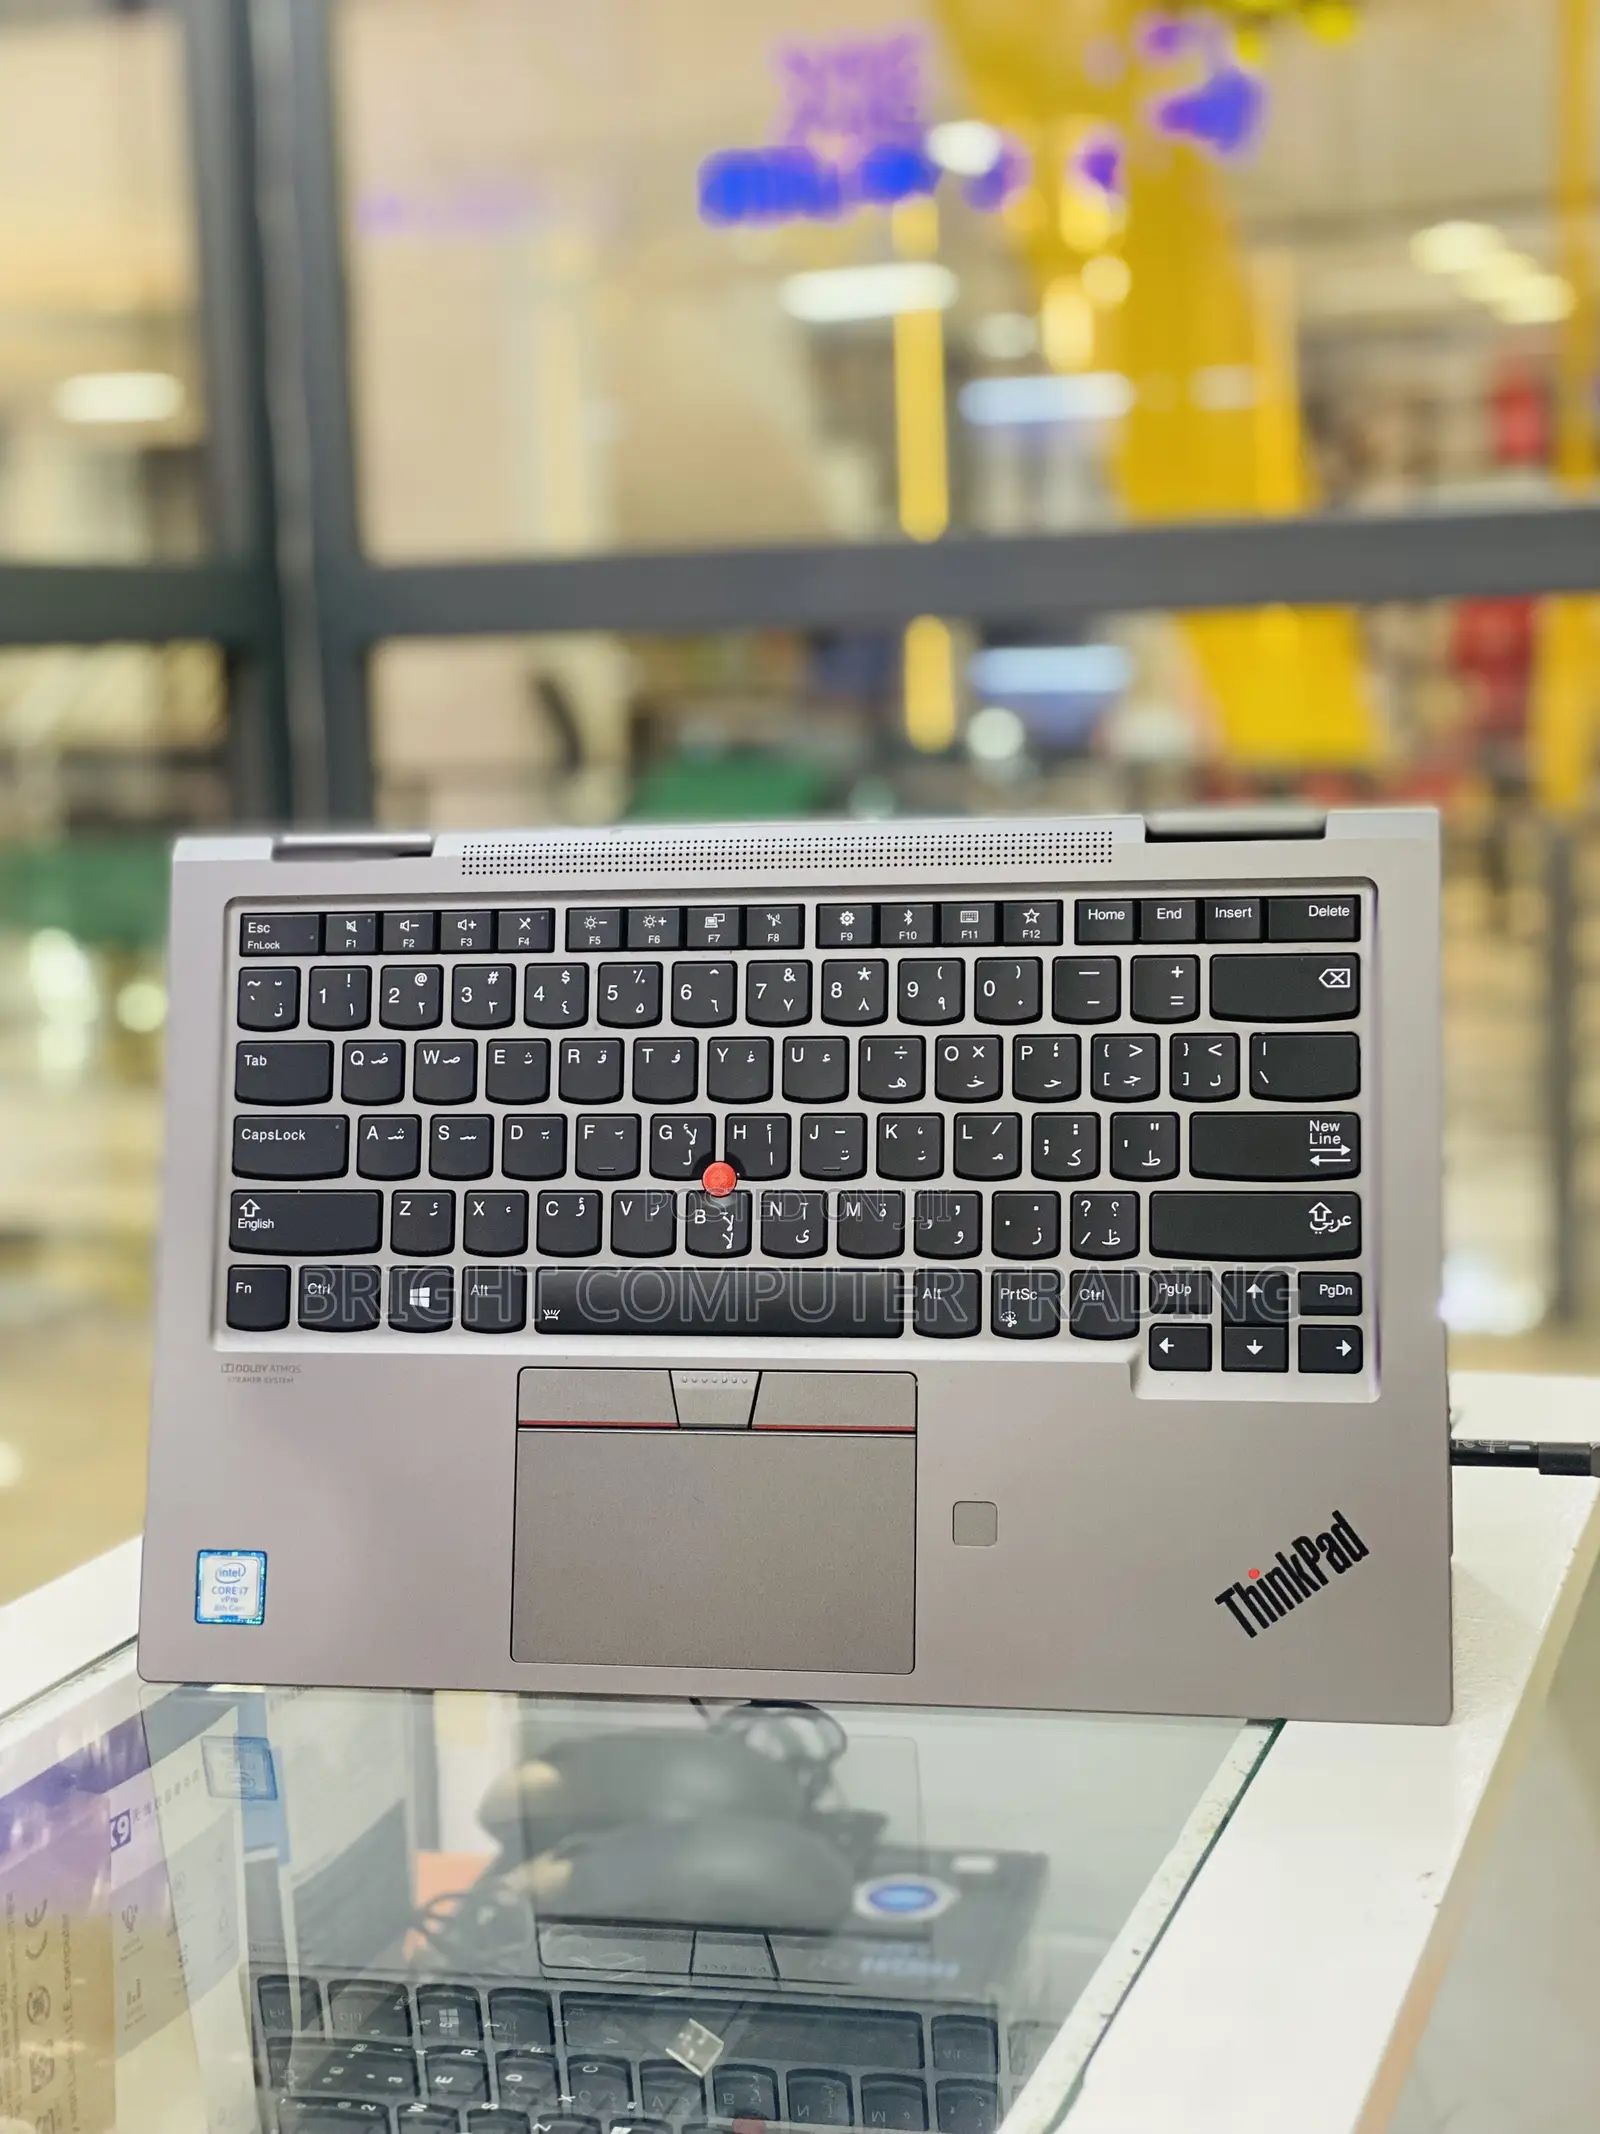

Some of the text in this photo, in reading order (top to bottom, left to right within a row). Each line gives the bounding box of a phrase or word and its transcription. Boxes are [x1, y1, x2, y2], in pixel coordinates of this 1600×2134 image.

[1089, 909, 1125, 920] Home
[1157, 908, 1181, 919] End
[1216, 907, 1251, 918] Insert
[1309, 905, 1349, 916] Delete
[249, 922, 270, 933] Esc
[1023, 930, 1040, 938] F12
[590, 936, 600, 944] F5
[649, 935, 660, 943] F6
[708, 934, 720, 942] F7
[768, 934, 779, 942] F8
[841, 933, 853, 941] F9
[899, 931, 917, 939] F10
[248, 941, 280, 949] FnLock
[403, 939, 414, 947] F2
[461, 938, 472, 946] F3
[347, 974, 350, 987] !
[415, 973, 427, 986] @
[488, 972, 498, 984] #
[562, 971, 570, 984] $
[633, 970, 645, 983] %
[784, 968, 795, 981] &
[462, 987, 472, 1002] 3
[534, 986, 544, 1001] 4
[608, 985, 617, 1000] 5
[681, 984, 691, 1000] 6
[756, 984, 767, 998] 7
[831, 982, 842, 998] 8
[908, 982, 918, 997] 9
[984, 980, 995, 996] 0
[320, 989, 325, 1003] 1
[389, 988, 399, 1003] 2
[351, 1051, 364, 1065] Q
[423, 1050, 439, 1064] W
[495, 1050, 505, 1064] E
[568, 1049, 579, 1063] R
[642, 1049, 653, 1063] T
[717, 1048, 728, 1062] Y
[792, 1048, 803, 1062] U
[945, 1046, 958, 1061] O
[1022, 1046, 1033, 1060] P
[245, 1055, 266, 1066] Tab
[511, 1125, 523, 1139] D
[585, 1125, 595, 1139] F
[734, 1125, 745, 1139] H
[810, 1125, 818, 1139] J
[886, 1124, 897, 1138] K
[963, 1125, 972, 1139] L
[1310, 1120, 1340, 1131] New
[242, 1129, 305, 1142] CapsLock
[367, 1126, 378, 1139] A
[439, 1125, 449, 1140] S
[659, 1125, 672, 1140] G
[1310, 1133, 1340, 1144] Line
[400, 1201, 411, 1215] Z
[473, 1202, 484, 1215] X
[546, 1201, 558, 1216] C
[621, 1201, 632, 1215] V
[770, 1202, 781, 1216] N
[847, 1202, 860, 1216] M
[1081, 1200, 1091, 1216] ?
[695, 1209, 706, 1223] B
[238, 1218, 274, 1231] English
[1309, 1215, 1351, 1234] عربي
[236, 1282, 251, 1293] Fn
[308, 1283, 330, 1294] Ctrl
[471, 1284, 488, 1296] Alt
[923, 1288, 941, 1299] Alt
[1001, 1288, 1037, 1300] PrtSc
[1160, 1284, 1191, 1296] PgUp
[1320, 1284, 1352, 1298] PgDn
[1080, 1289, 1104, 1300] Ctrl
[236, 1364, 268, 1373] DOLBY
[220, 1568, 241, 1577] intel
[1215, 1510, 1370, 1638] ThinkPad
[212, 1586, 249, 1595] CORE i7
